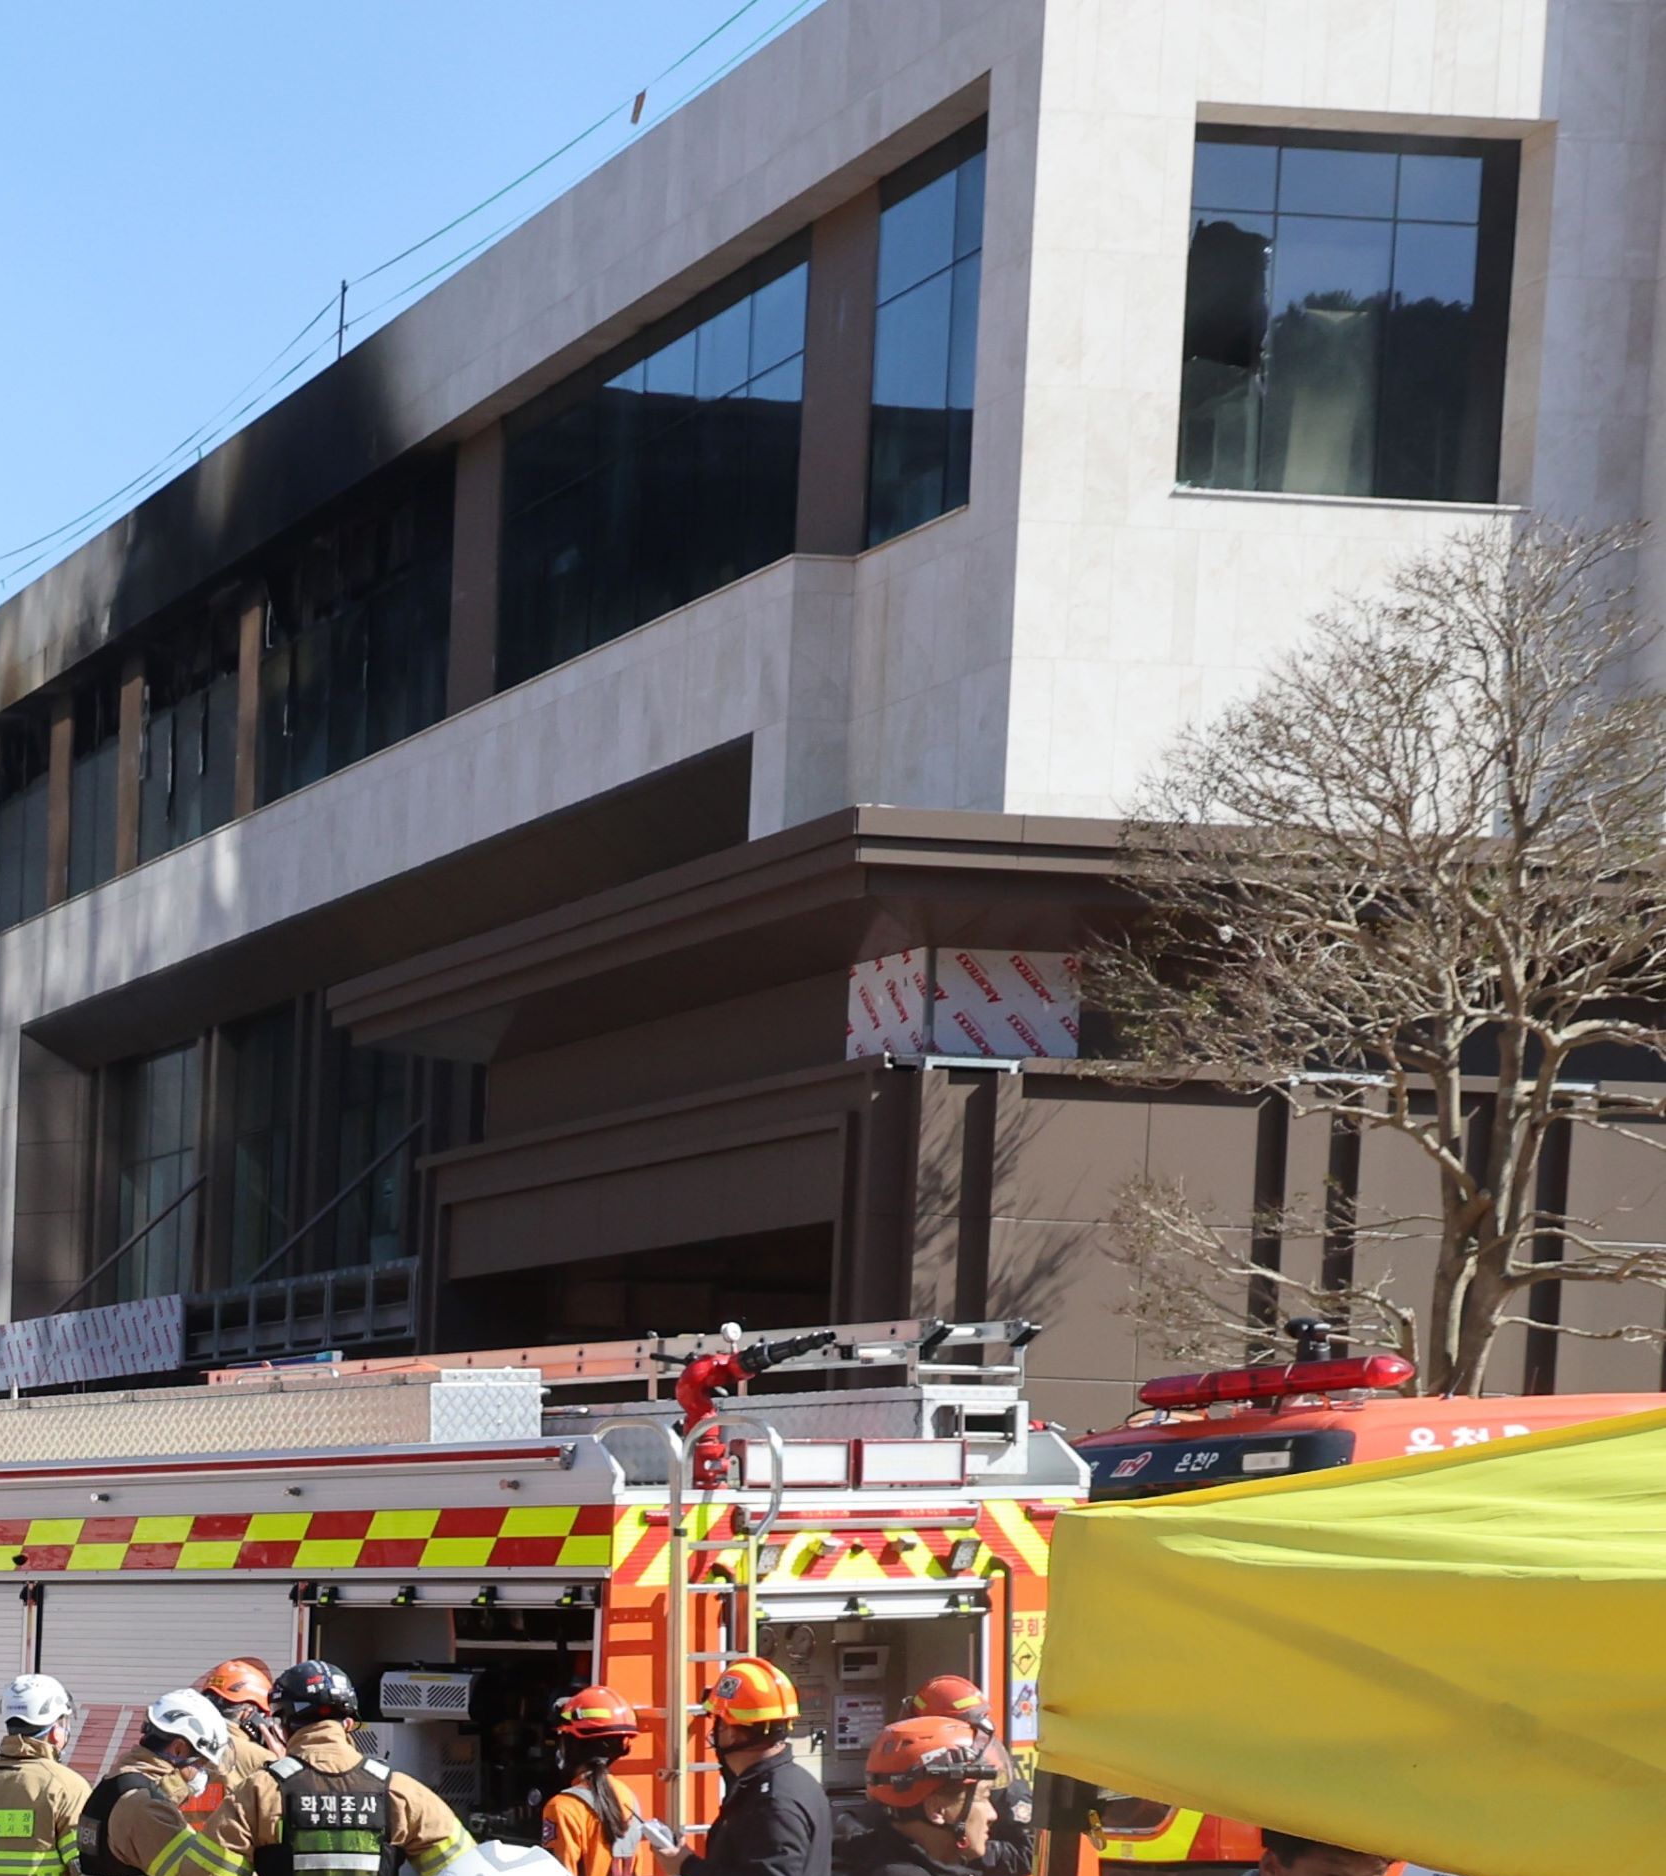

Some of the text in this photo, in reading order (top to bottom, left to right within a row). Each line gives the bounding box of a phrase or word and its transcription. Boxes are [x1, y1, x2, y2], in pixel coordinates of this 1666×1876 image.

[1174, 1452, 1219, 1473] 온천P
[301, 1796, 378, 1814] 화재조사
[310, 1813, 369, 1826] 부산소방
